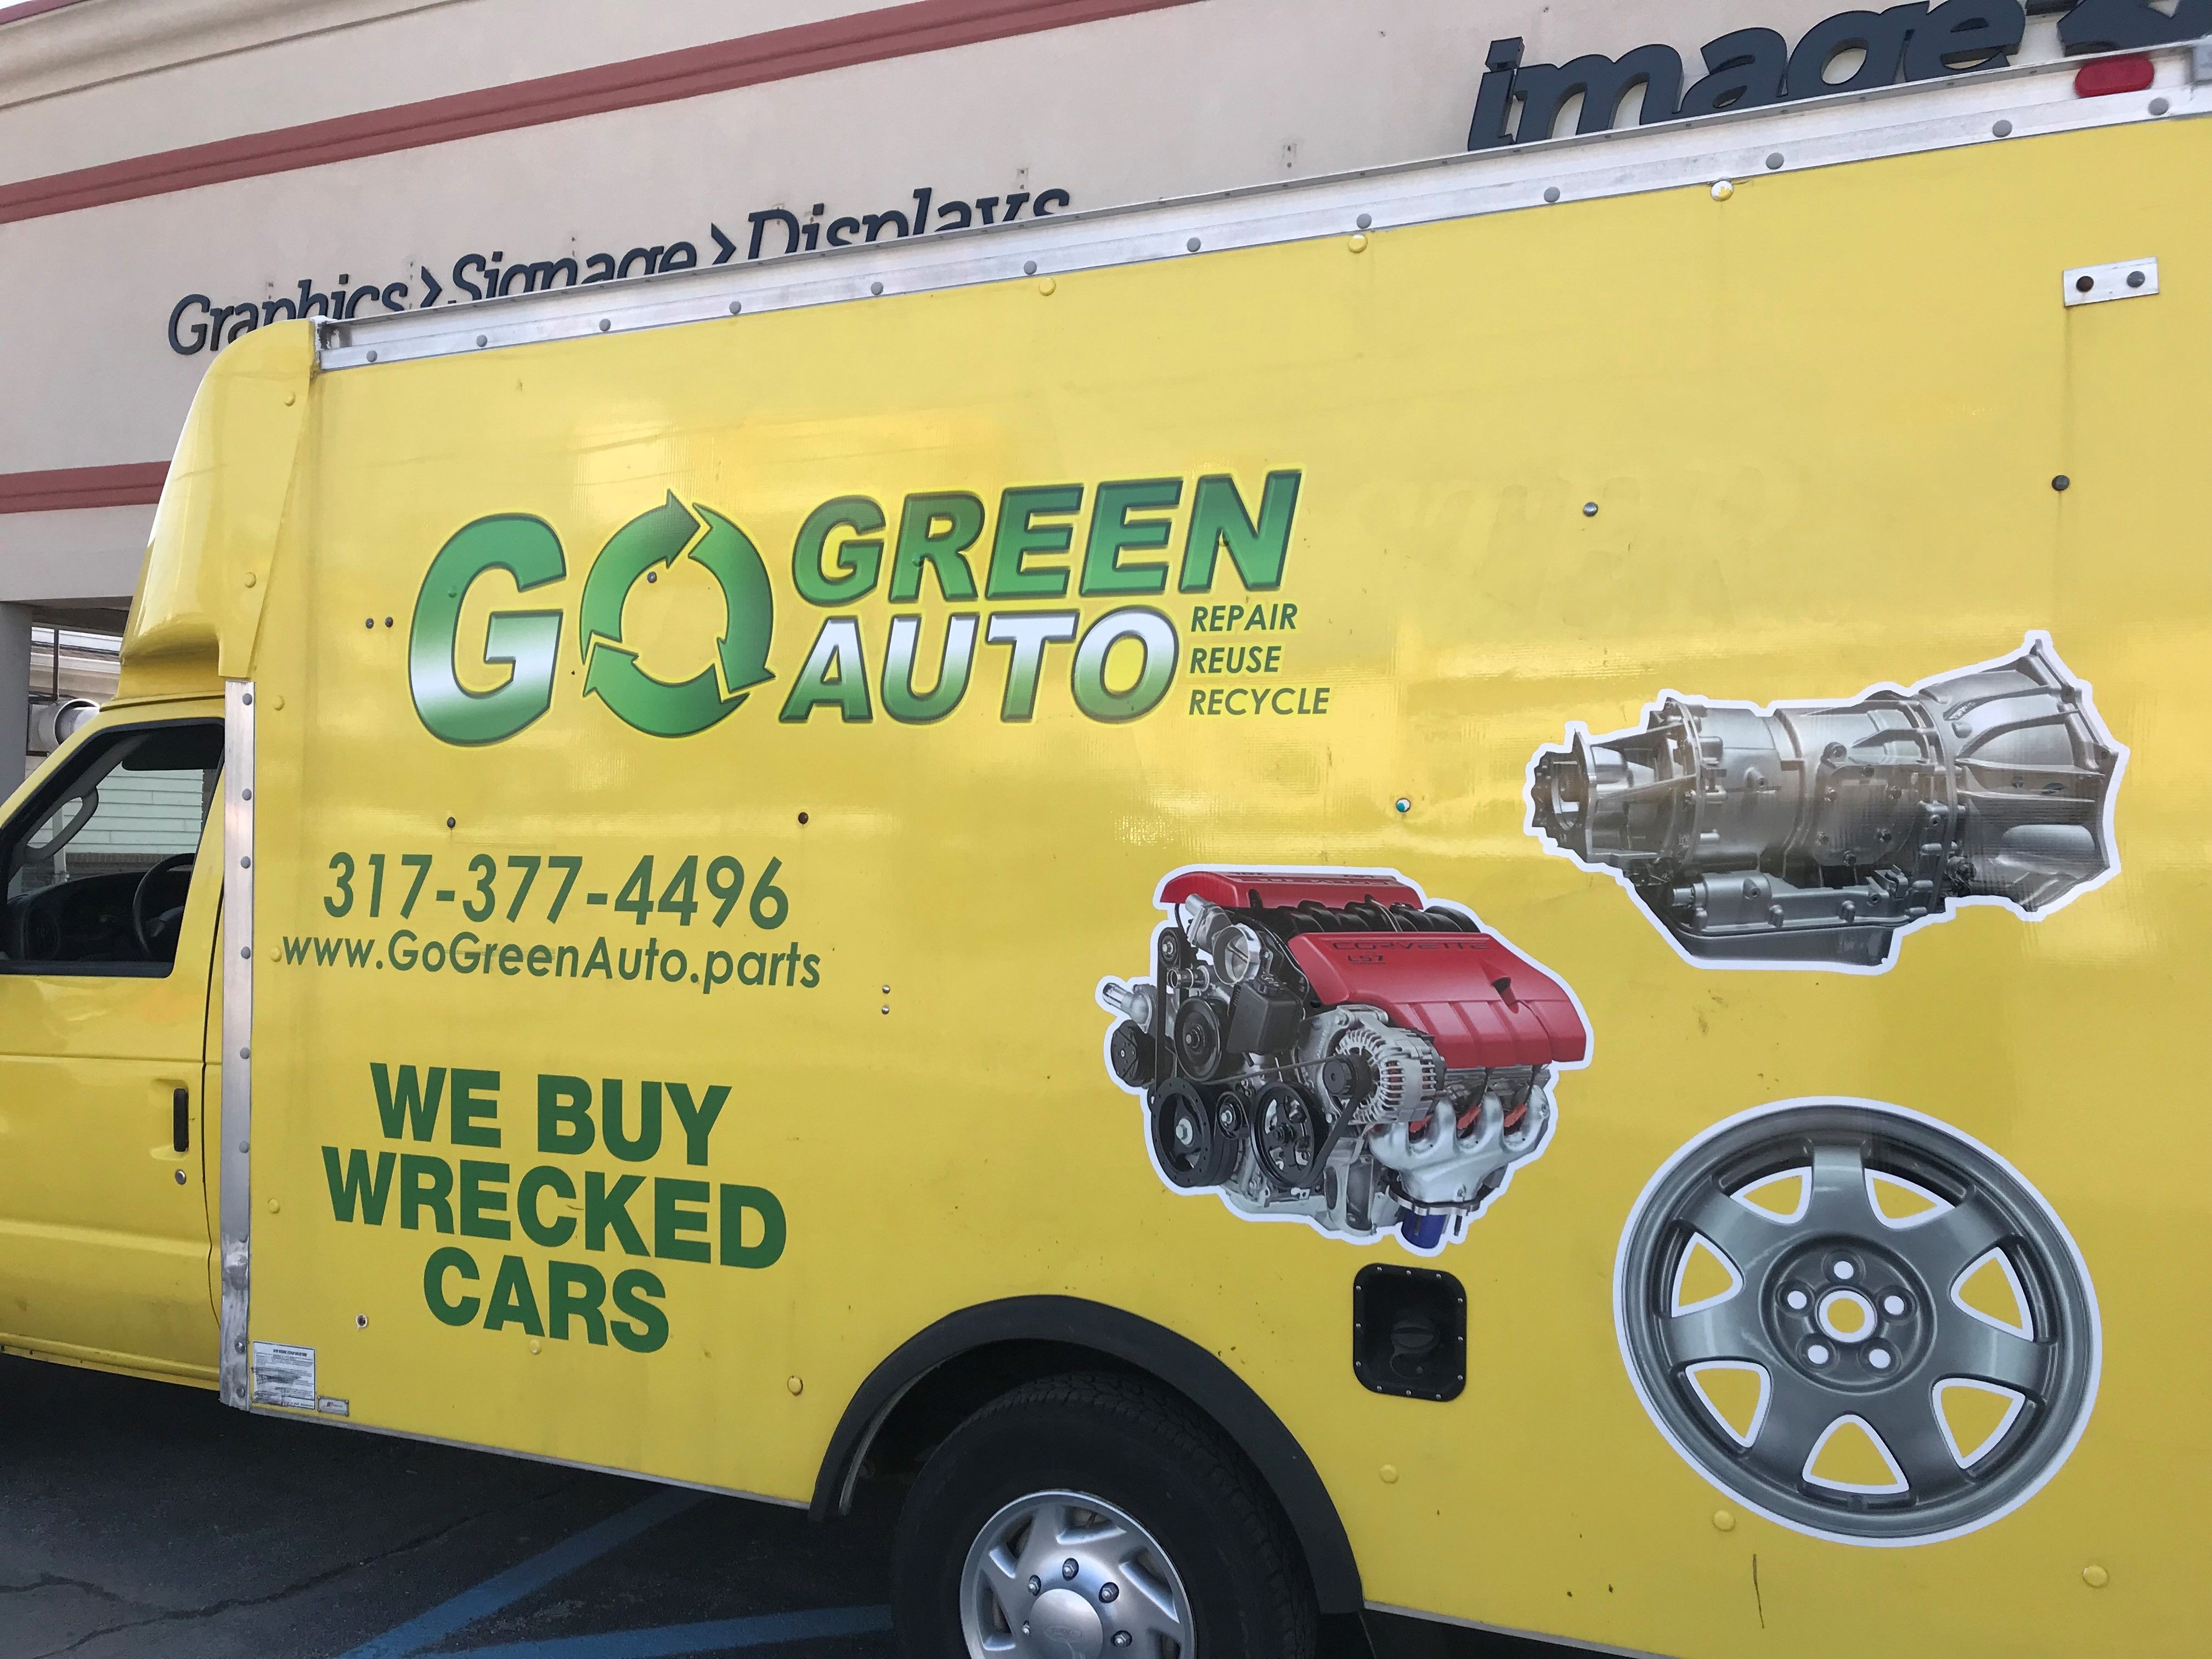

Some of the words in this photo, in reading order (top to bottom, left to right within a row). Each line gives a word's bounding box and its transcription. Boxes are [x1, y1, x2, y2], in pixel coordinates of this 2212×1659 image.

[791, 470, 1302, 606] GREEN
[1190, 646, 1281, 674] REUSE
[1191, 603, 1297, 632] REPAIR
[778, 606, 1178, 724] AUTO
[1189, 687, 1330, 715] RECYCLE
[324, 851, 789, 930] 317-377-4496
[283, 929, 821, 994] www.GoGreenAuto.parts
[370, 1062, 501, 1148] WE
[537, 1074, 732, 1166] BUY
[321, 1146, 787, 1269] WRECKED
[424, 1246, 669, 1353] CARS
